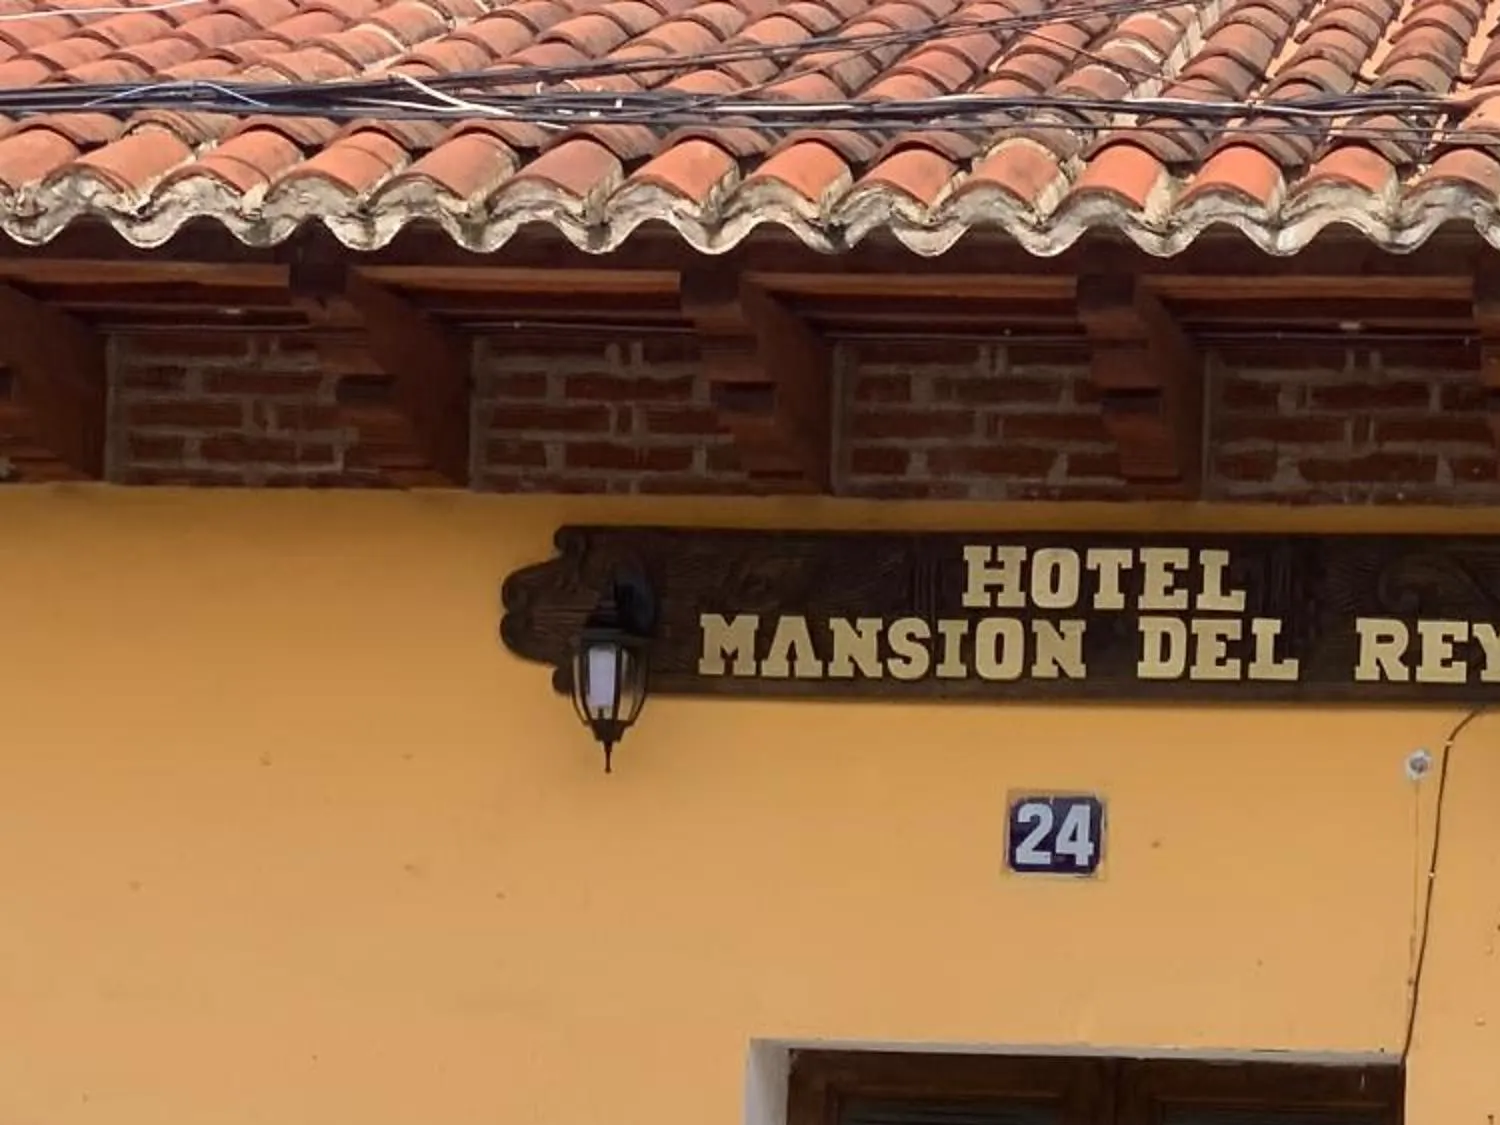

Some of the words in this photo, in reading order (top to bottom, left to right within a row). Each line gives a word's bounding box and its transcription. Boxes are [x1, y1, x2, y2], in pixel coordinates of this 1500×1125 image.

[961, 544, 1247, 611] HOTEL
[698, 612, 1087, 681] MANSION
[1136, 615, 1300, 682] DEL
[1013, 801, 1096, 868] 24
